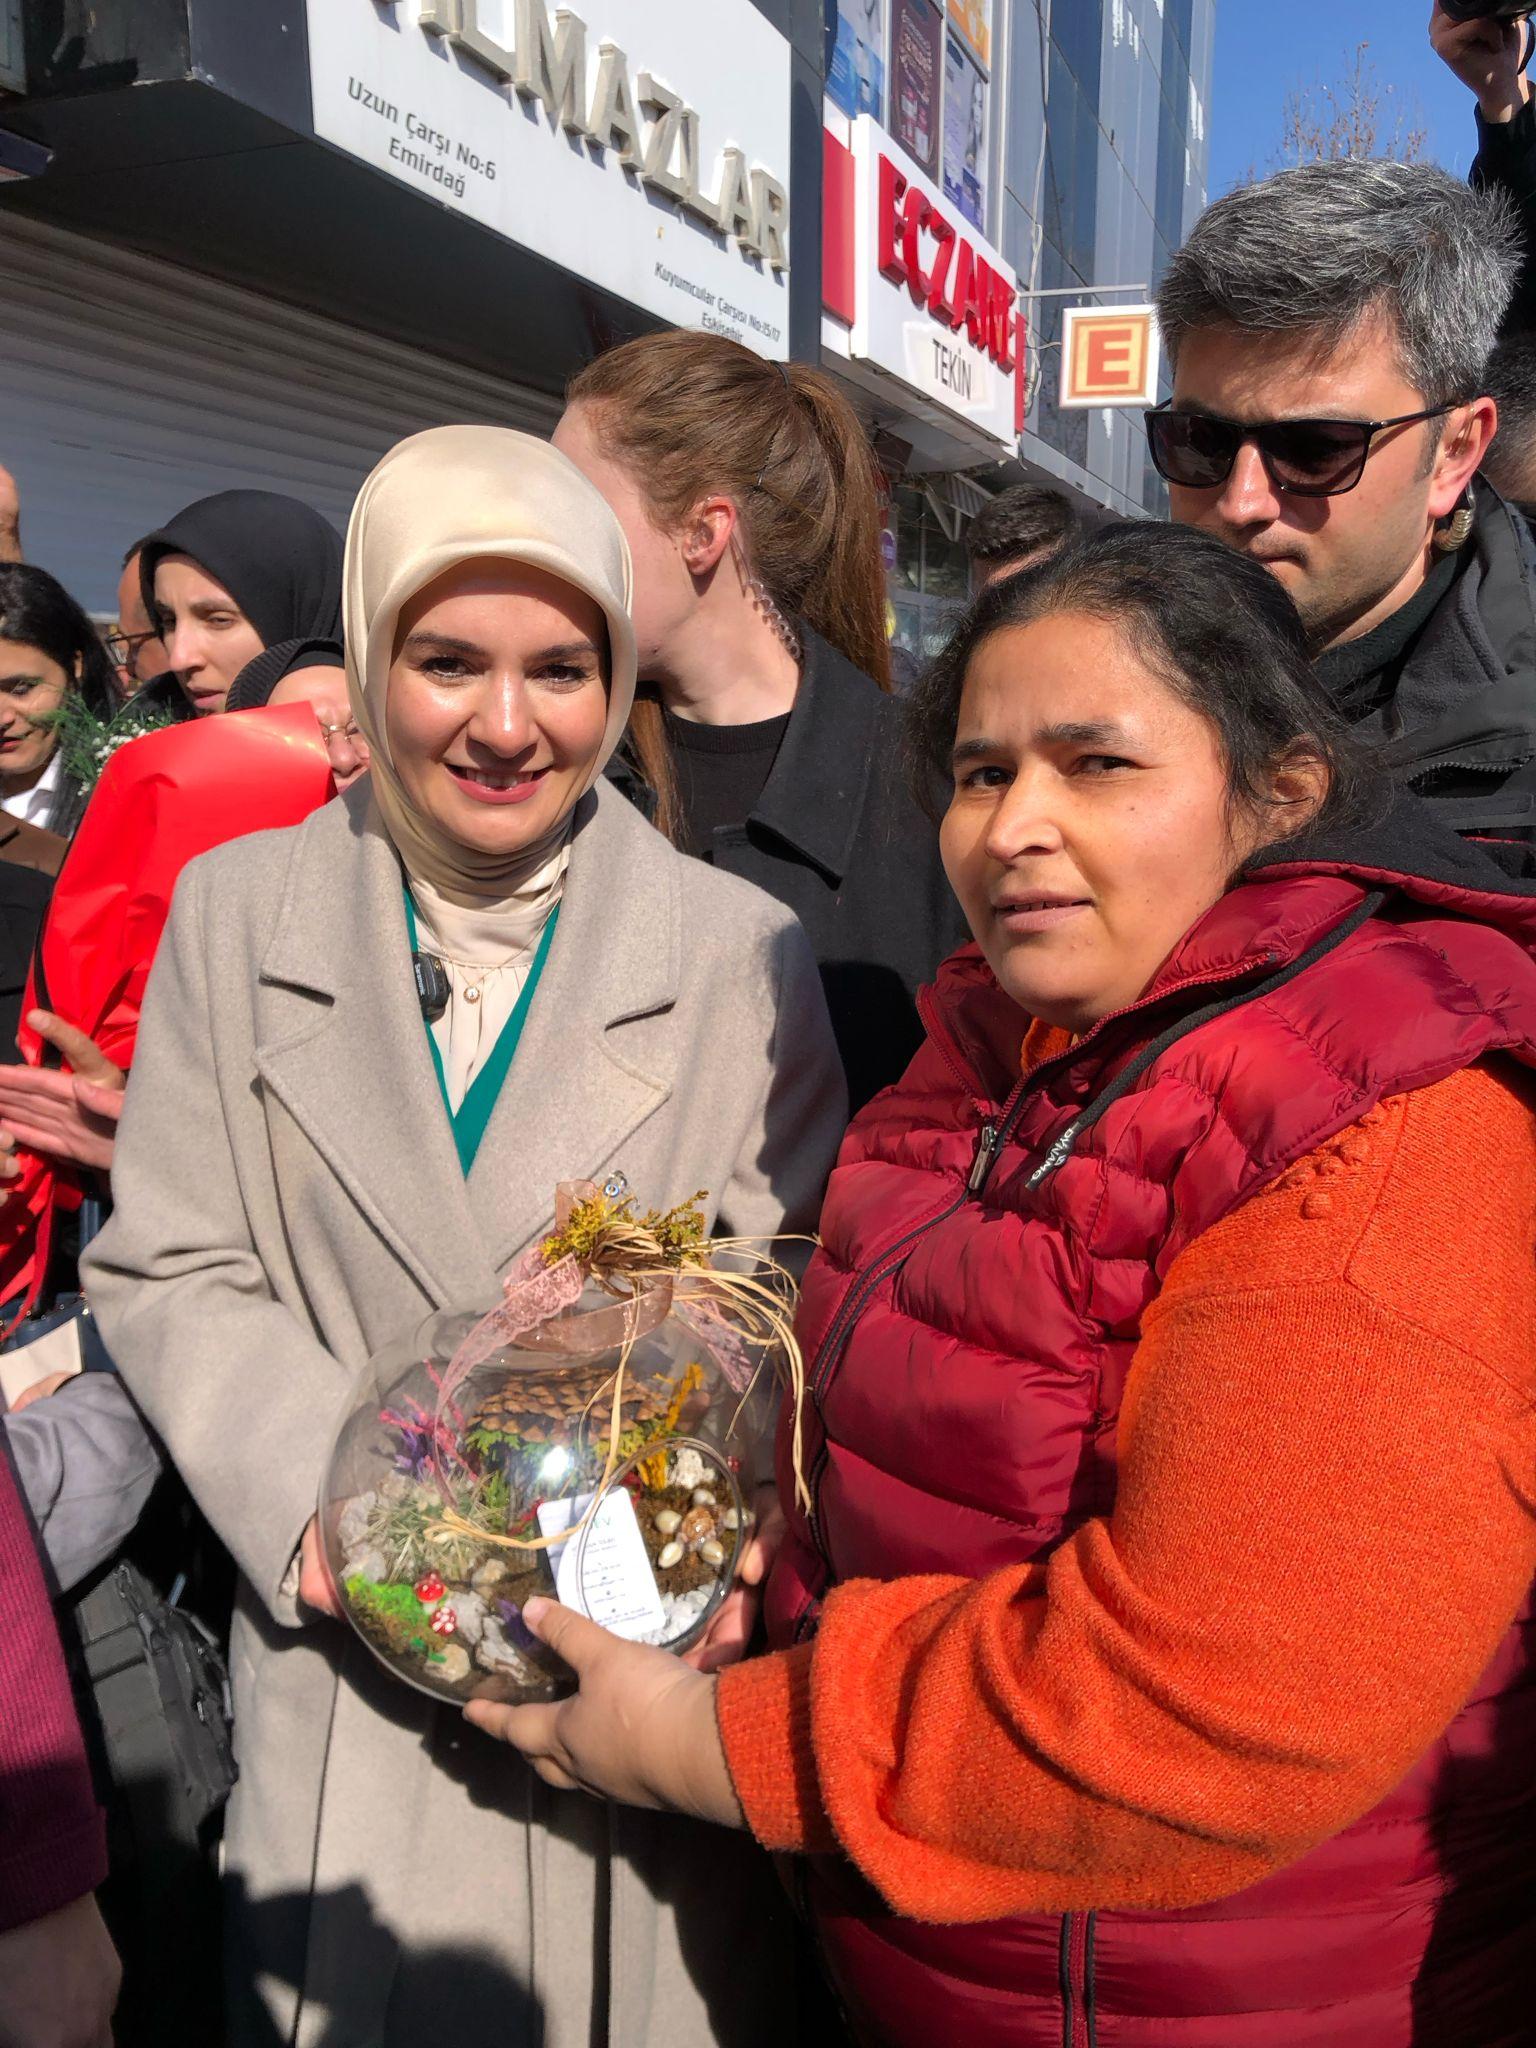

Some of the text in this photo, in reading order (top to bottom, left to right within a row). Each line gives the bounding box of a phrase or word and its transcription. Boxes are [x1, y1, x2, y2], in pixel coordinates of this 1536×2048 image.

[347, 76, 496, 180] Uzun Çarşı No:6
[388, 137, 466, 198] Emirdağ
[654, 262, 716, 306] Kuyumcular
[717, 297, 748, 324] Çarşısı
[932, 338, 972, 400] TEKİN
[1086, 328, 1132, 386] E
[1031, 1128, 1074, 1180] DYNAMO
